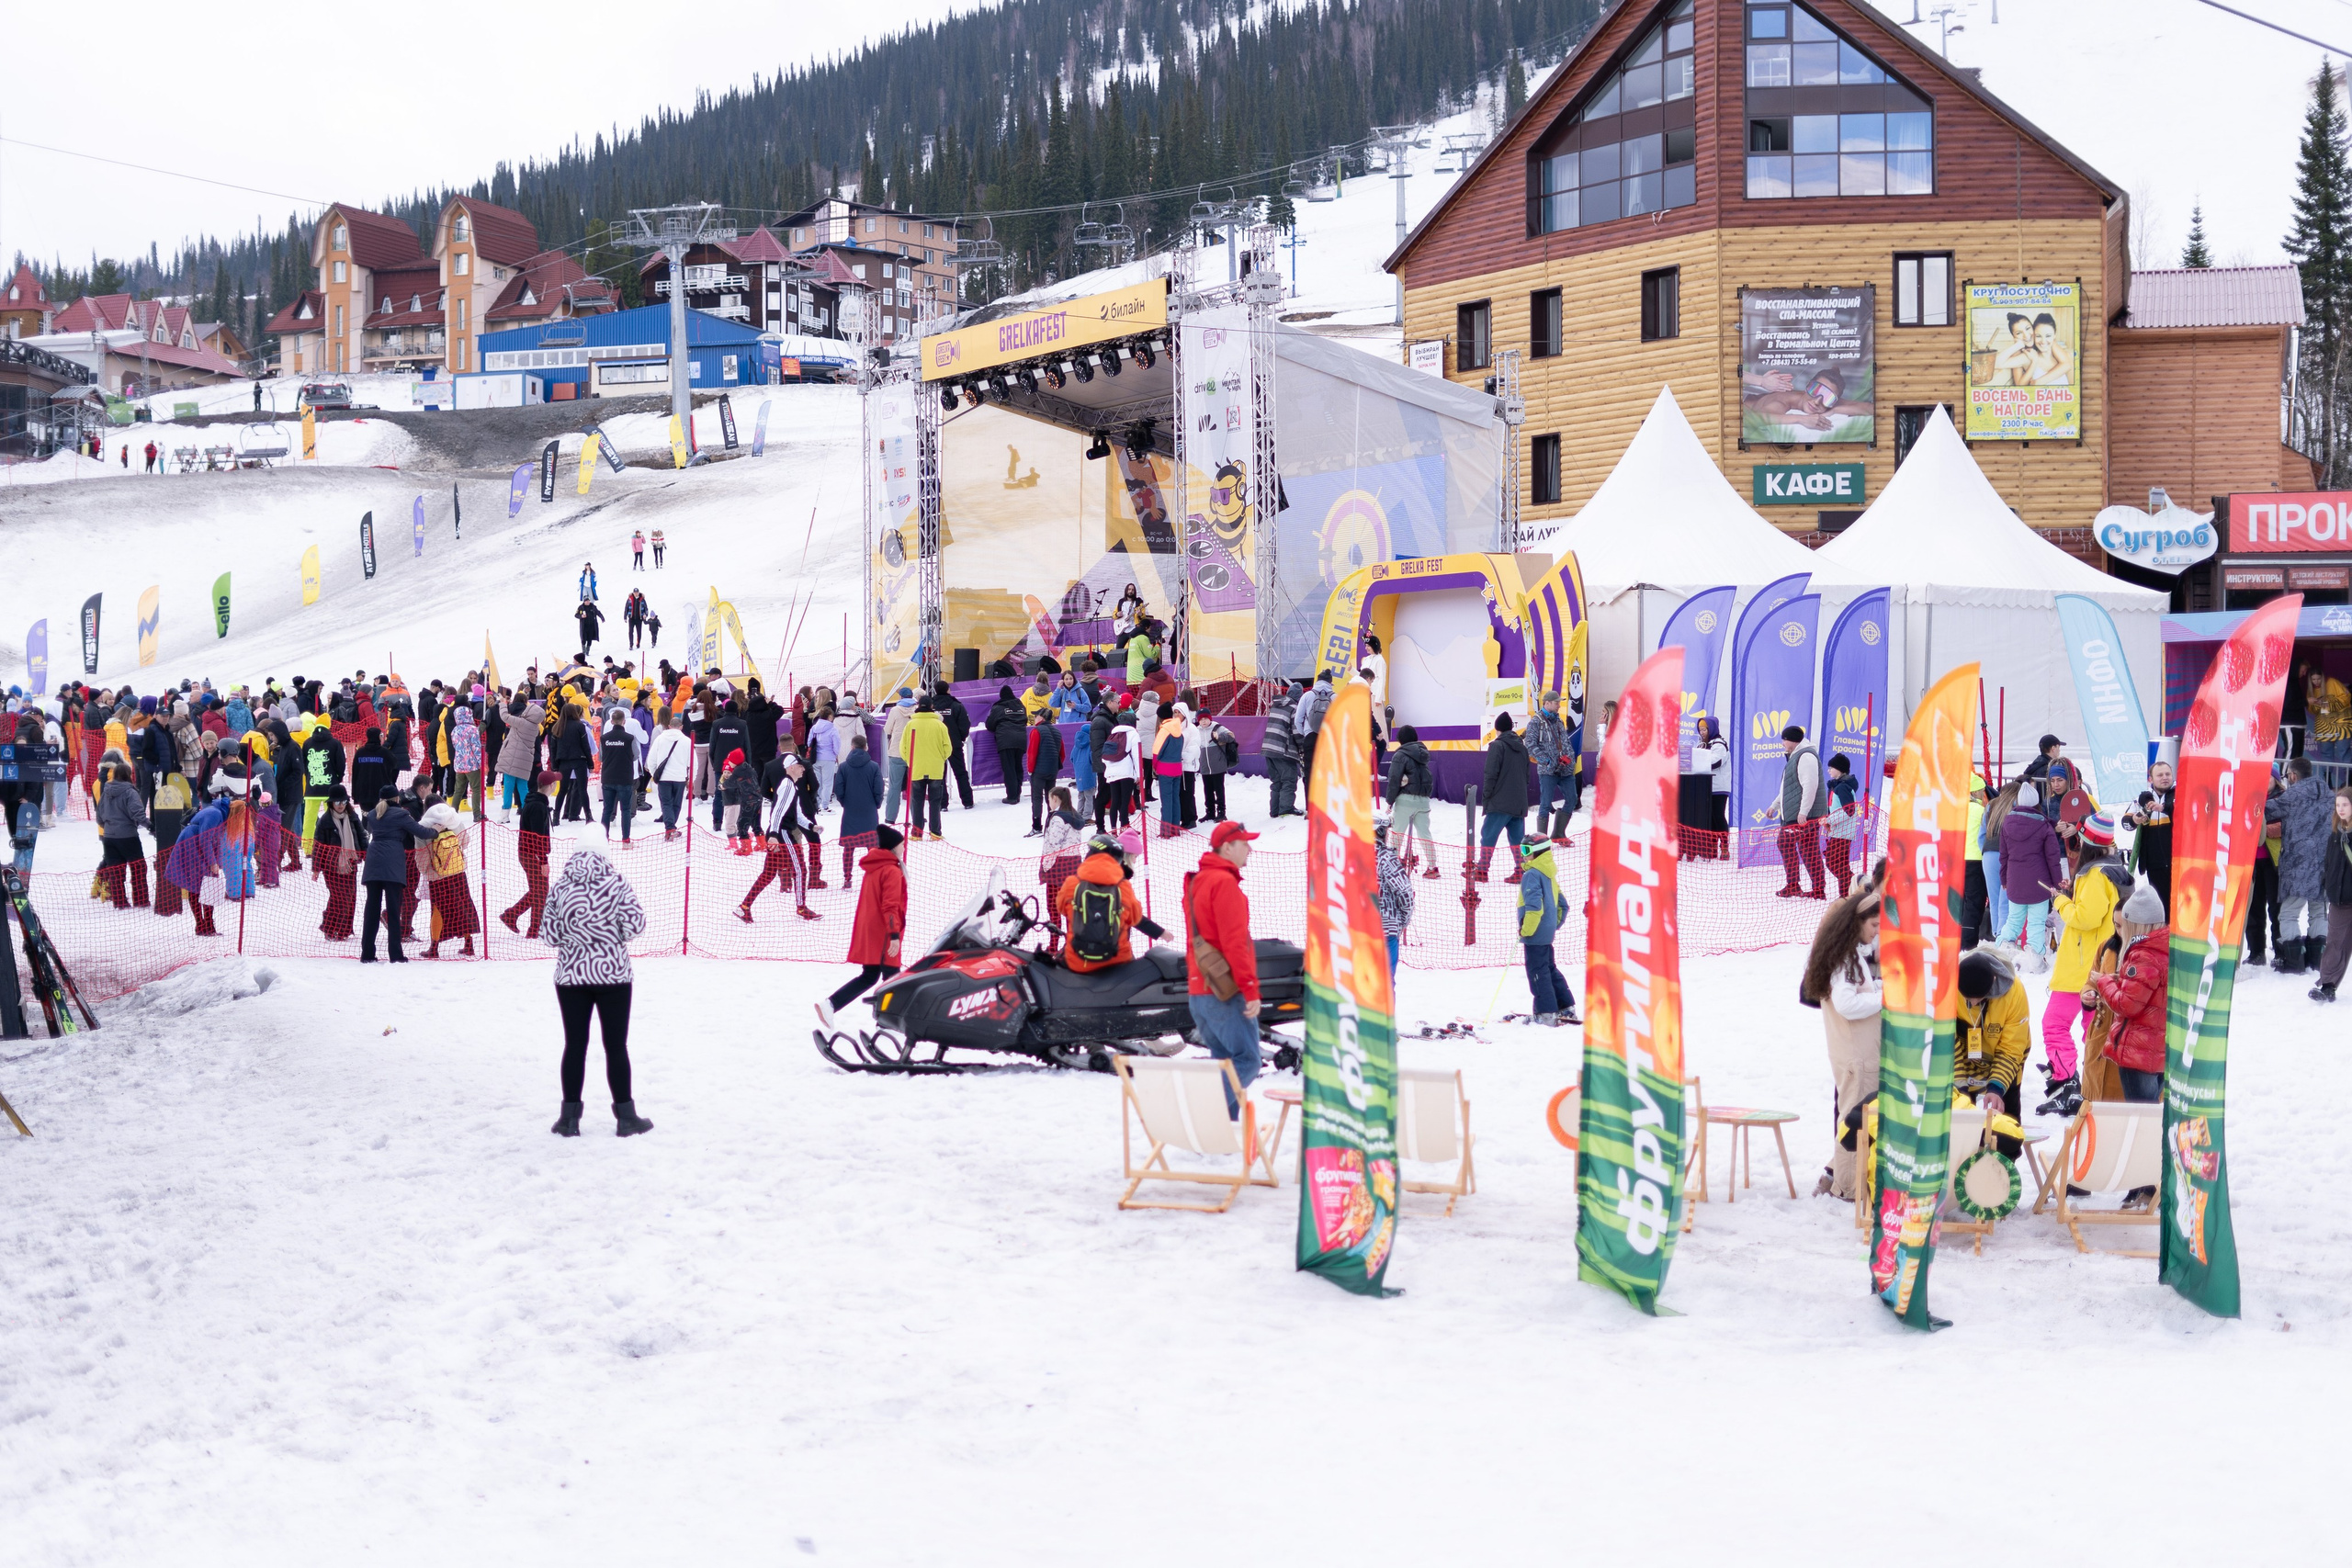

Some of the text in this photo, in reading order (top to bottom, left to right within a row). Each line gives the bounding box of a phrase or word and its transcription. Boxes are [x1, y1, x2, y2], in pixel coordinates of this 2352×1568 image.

[1973, 287, 2071, 296] КРУГЛОСУТОЧНО
[1111, 299, 1145, 319] билайн
[1754, 296, 1861, 310] ВОССТАНАВЛИВАЮЩИЙ
[1779, 310, 1836, 320] СПА-МАССАЖ
[1000, 311, 1067, 352] GRELKAFEST
[1755, 331, 1810, 340] Восстановись
[1775, 340, 1828, 349] Термальном
[1829, 339, 1861, 348] Центре
[1973, 390, 2073, 402] ВОСЕМЬ БАНЬ
[1995, 404, 2051, 416] НА ГОРЕ
[1766, 471, 1852, 496] КАФЕ
[2101, 522, 2210, 554] Сугроб
[1401, 558, 1443, 575] GRELKA FEST
[2227, 574, 2282, 583] ИНСТРУКТОРЫ
[1833, 735, 1866, 746] Главные
[948, 986, 1001, 1017] LYNX
[1617, 818, 1669, 1256] фрутилад
